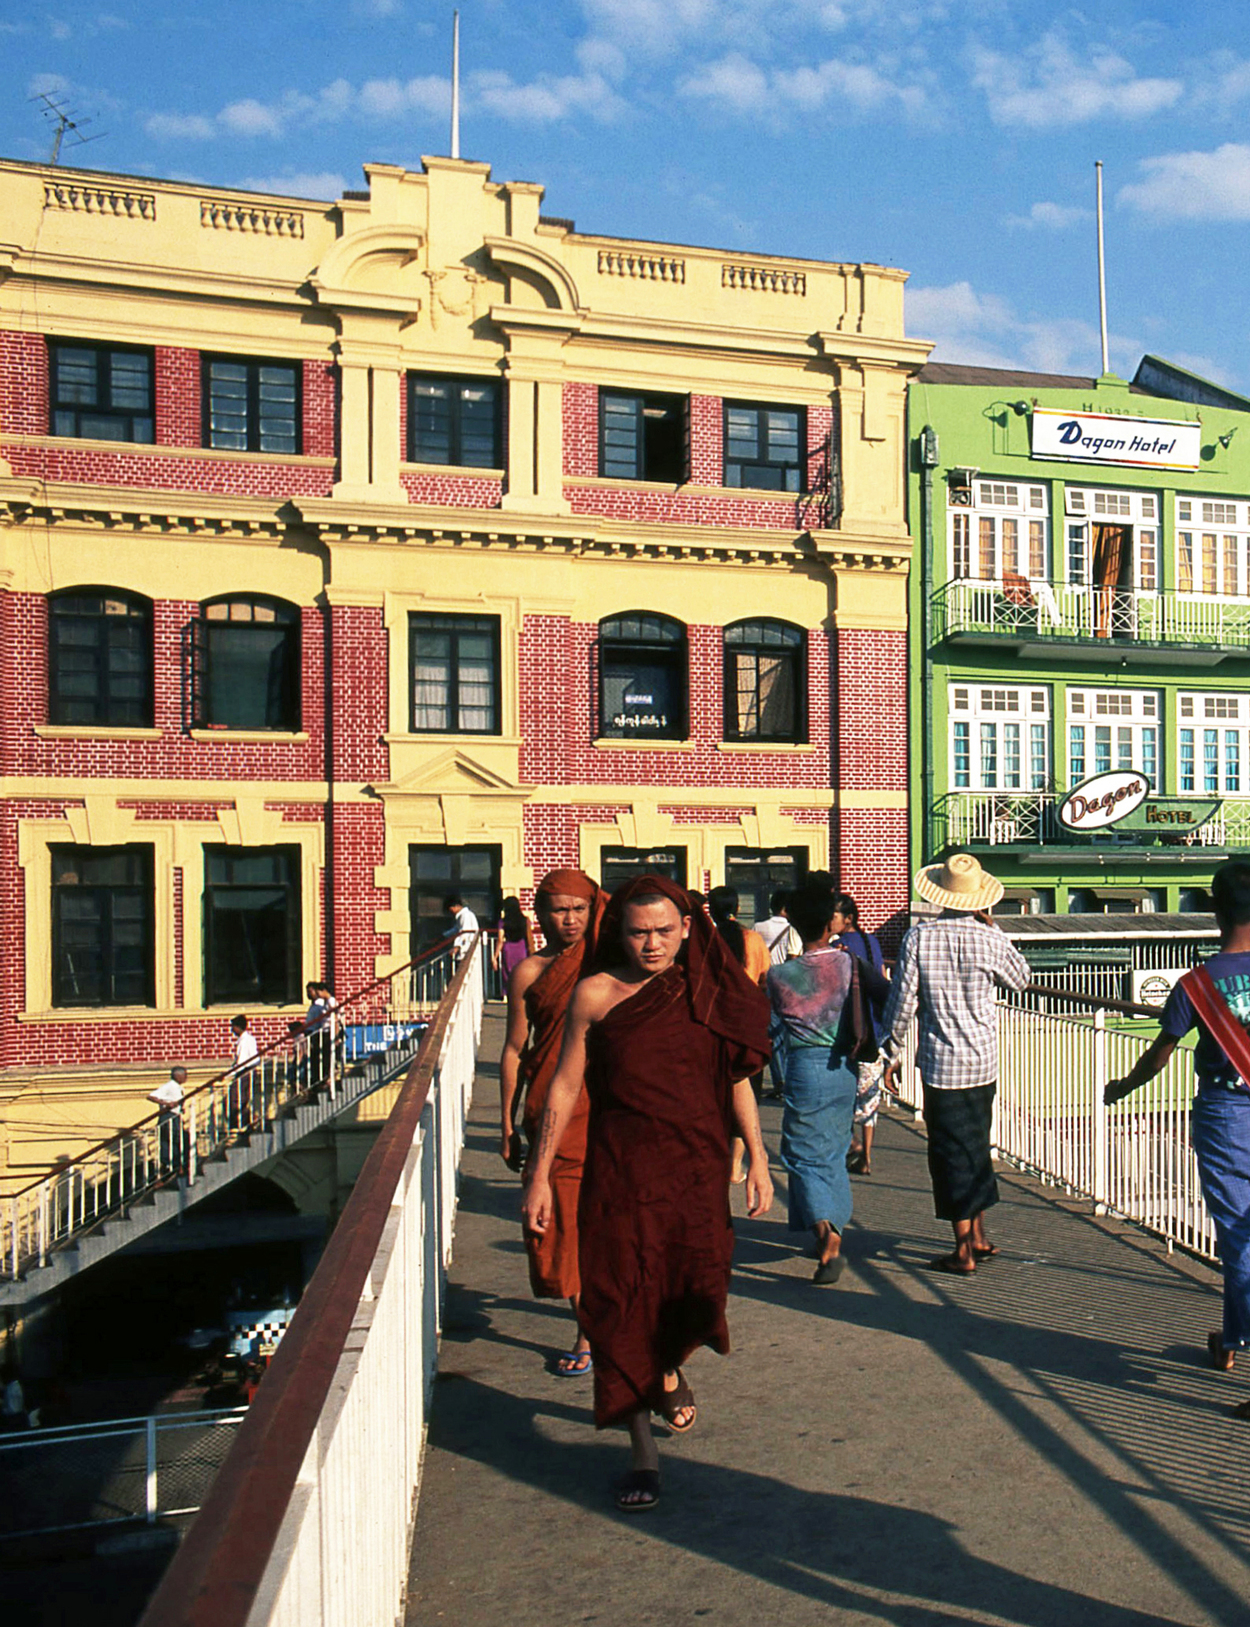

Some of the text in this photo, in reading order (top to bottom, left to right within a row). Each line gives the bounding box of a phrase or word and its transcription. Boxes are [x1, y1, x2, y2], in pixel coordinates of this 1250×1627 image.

[1056, 420, 1177, 455] Dagon Hotel
[1068, 779, 1143, 823] Dagon
[1145, 804, 1198, 824] HOTEL
